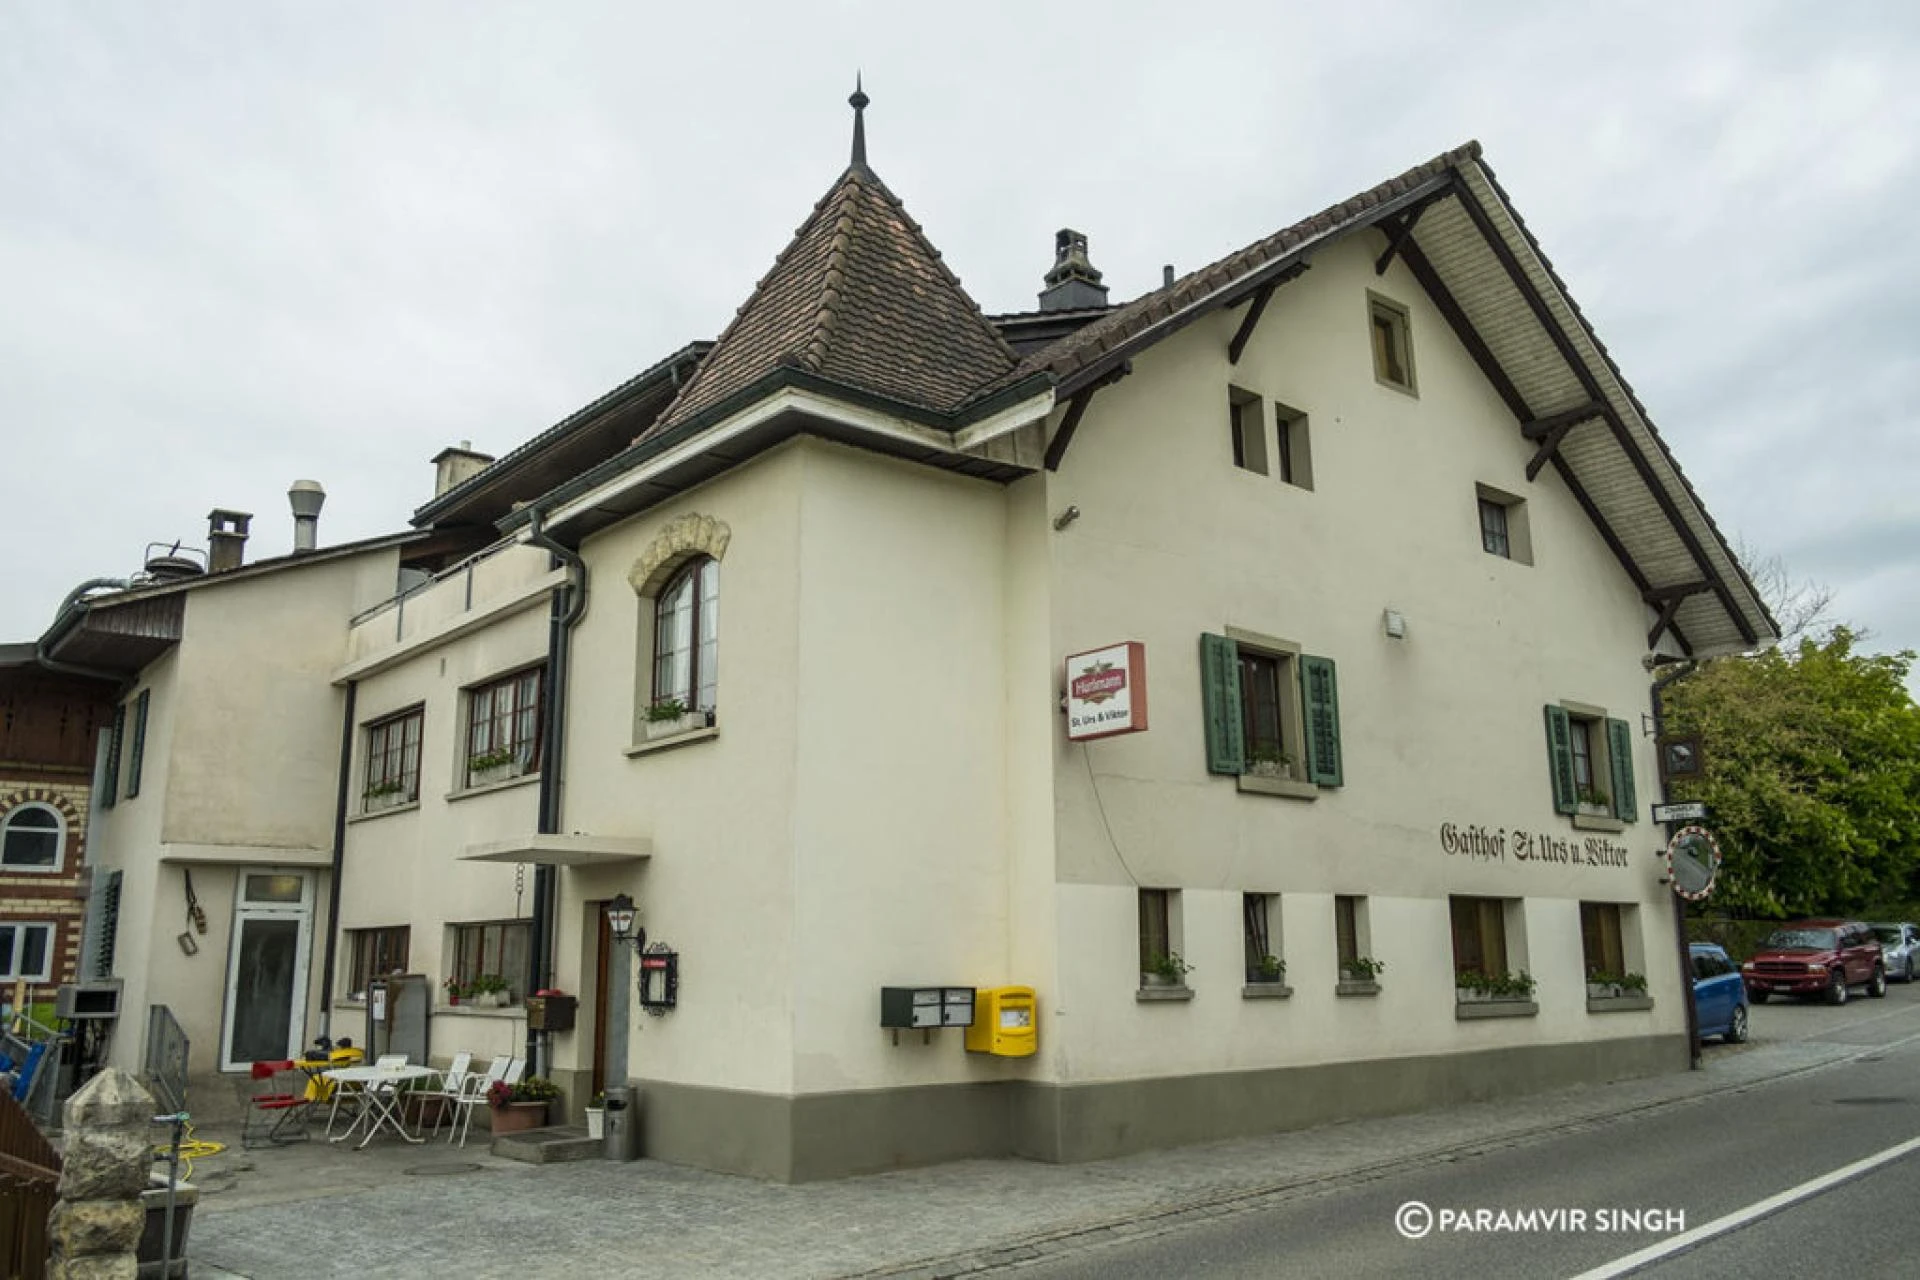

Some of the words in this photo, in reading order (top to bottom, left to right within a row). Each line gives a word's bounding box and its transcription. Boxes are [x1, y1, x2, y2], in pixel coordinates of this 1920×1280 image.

[1082, 715, 1095, 725] Urs
[1099, 712, 1105, 721] &
[1105, 710, 1127, 720] Viktor
